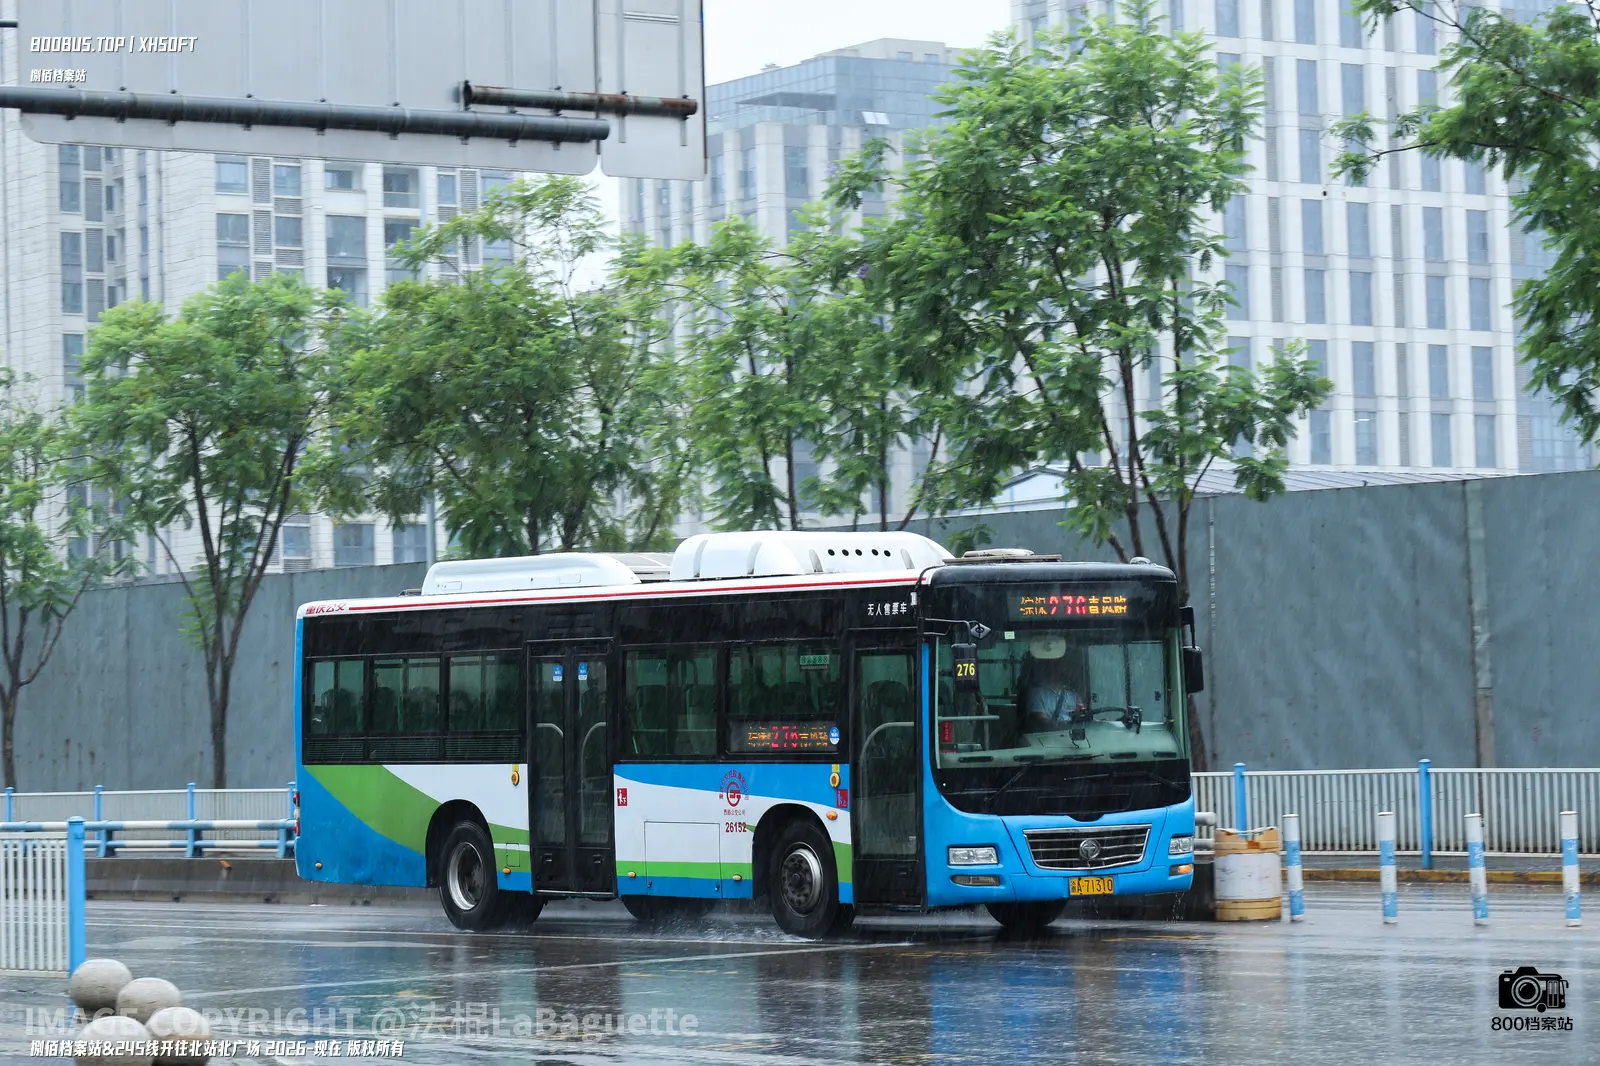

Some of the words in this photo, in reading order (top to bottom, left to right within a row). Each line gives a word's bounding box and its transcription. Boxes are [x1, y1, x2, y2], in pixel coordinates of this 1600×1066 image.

[867, 601, 908, 616] 无人售票车
[956, 663, 976, 677] 276
[725, 821, 747, 833] 26152
